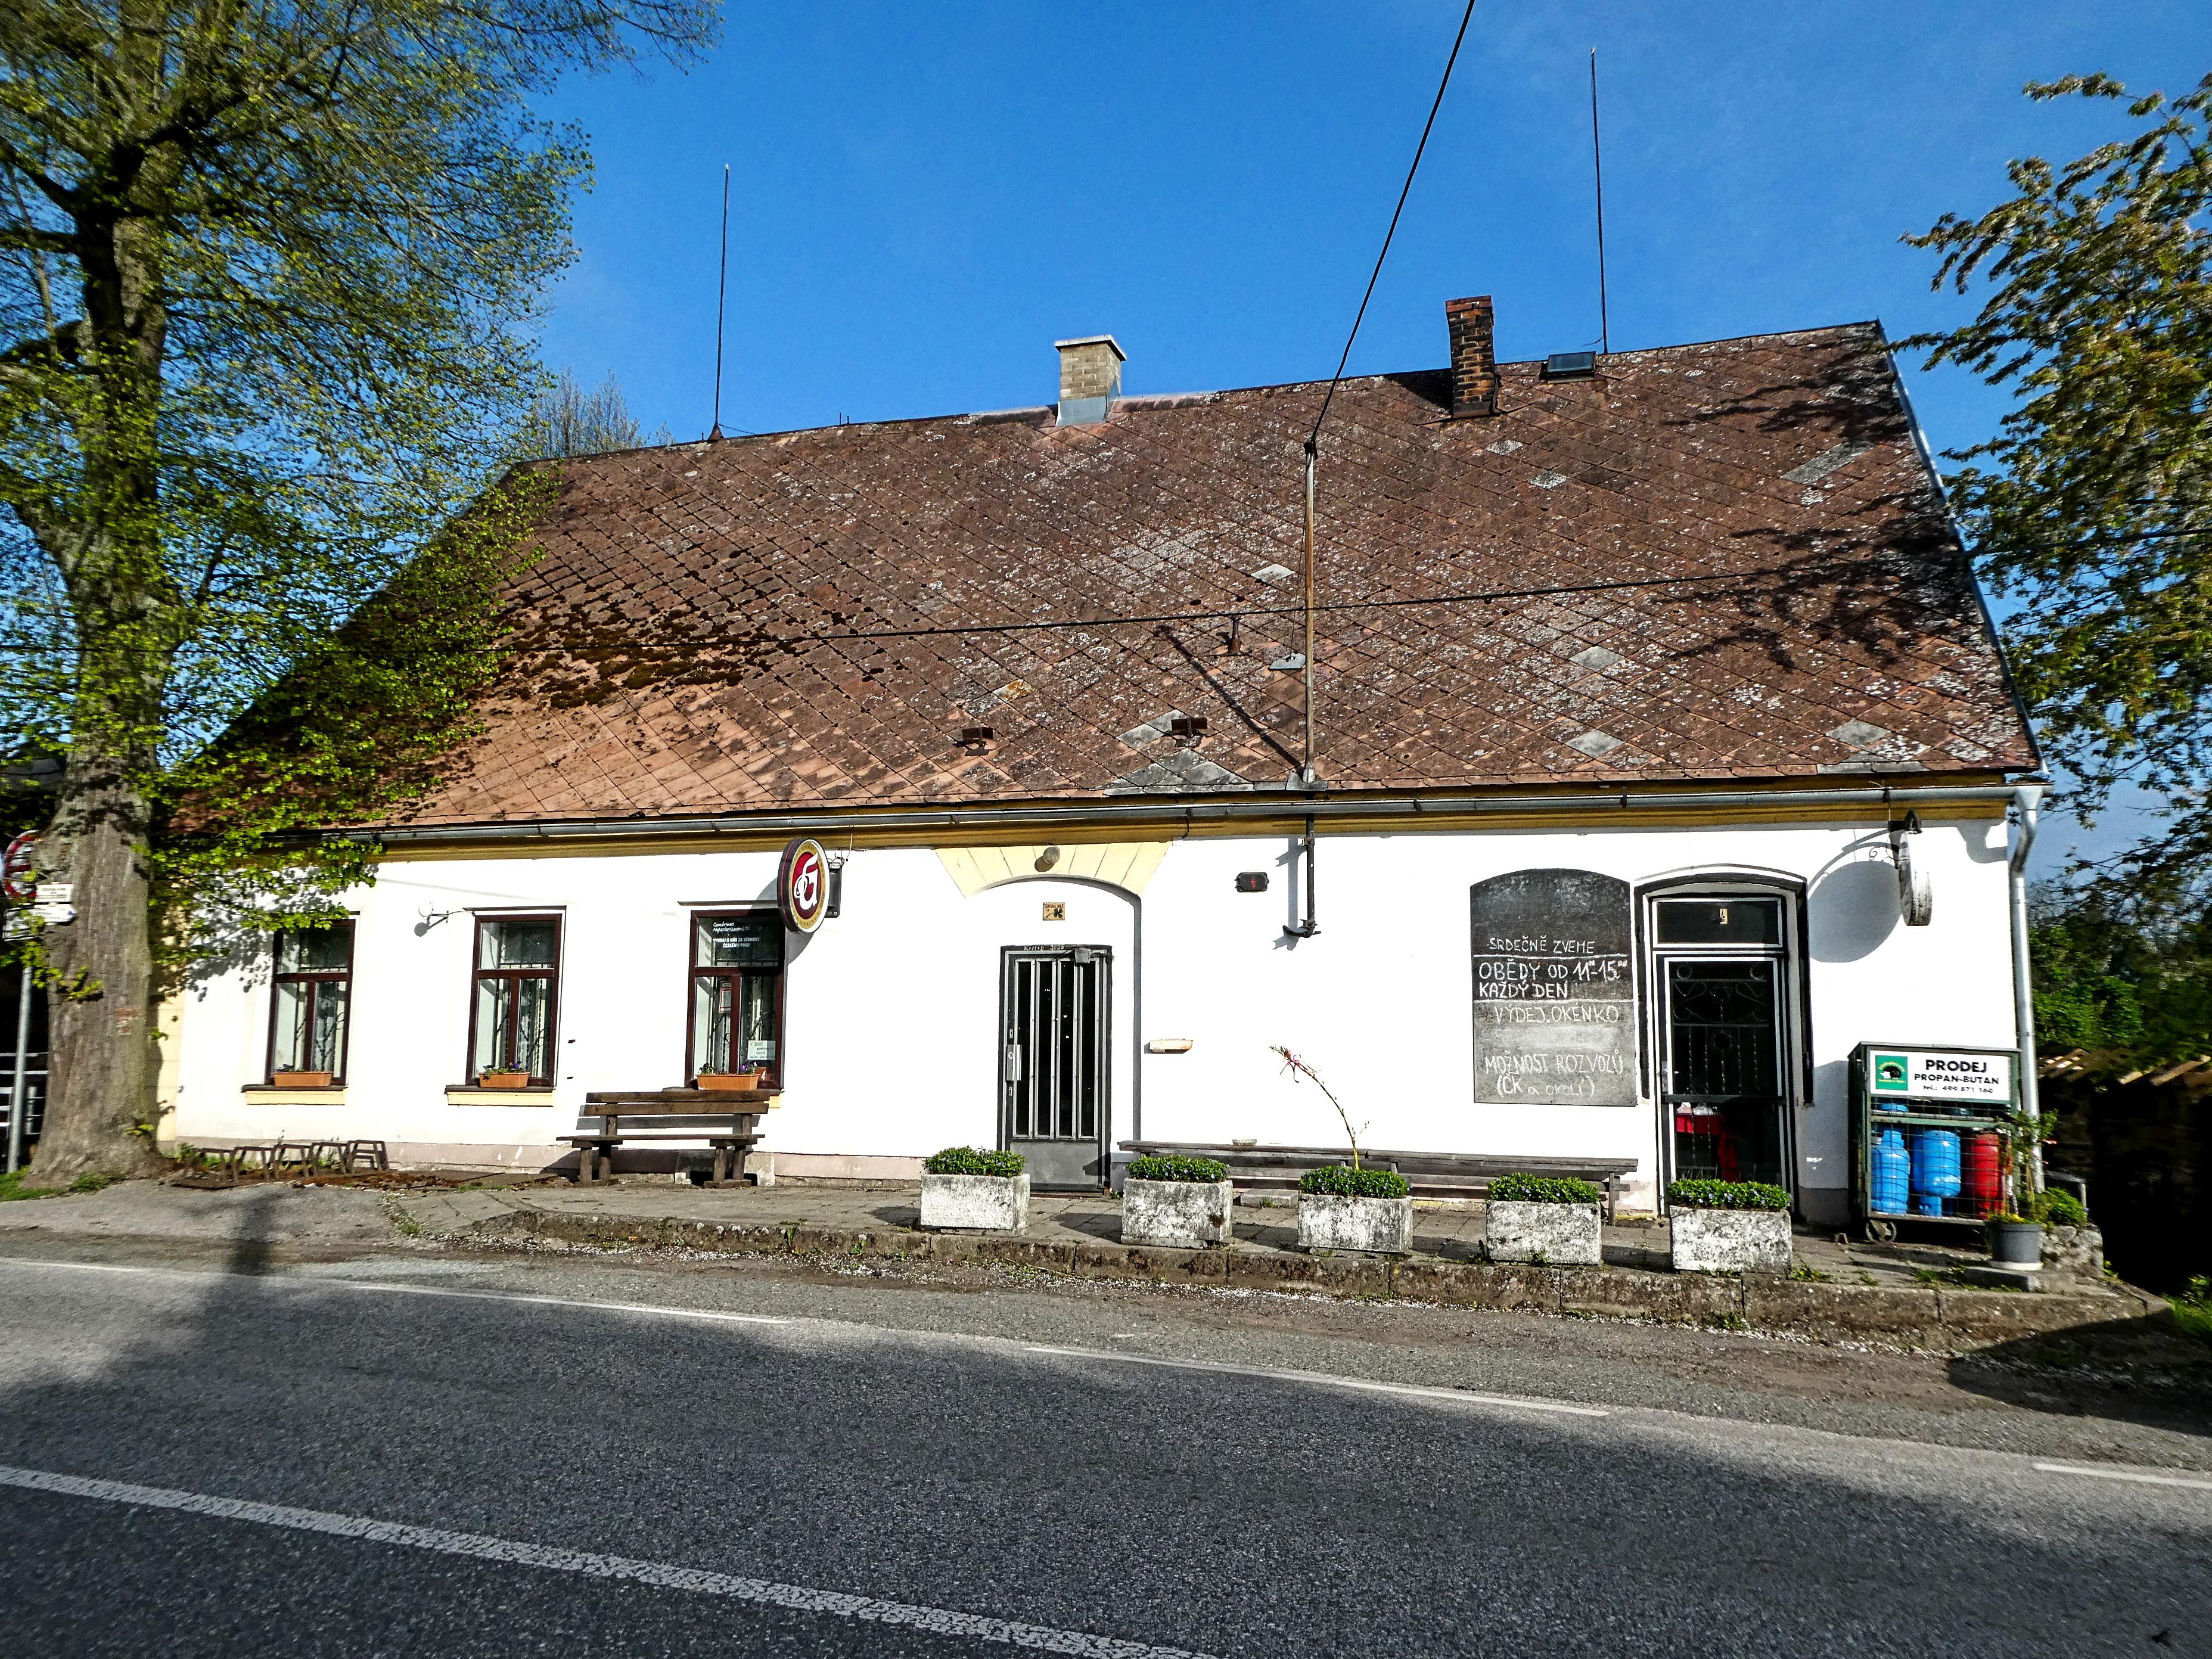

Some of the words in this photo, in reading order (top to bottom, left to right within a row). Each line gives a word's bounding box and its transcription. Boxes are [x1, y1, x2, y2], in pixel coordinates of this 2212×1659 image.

[1488, 935, 1547, 952] SRDEČNĚ
[1553, 940, 1595, 954] ZVEME
[1478, 958, 1540, 981] OBĚDY
[1548, 964, 1568, 979] OD
[1479, 979, 1530, 999] KAŽDÝ
[1531, 981, 1568, 999] DEN
[1484, 1049, 1548, 1075] MOŽNOST
[1555, 1049, 1624, 1074] ROZVOZŮ
[1925, 1059, 1987, 1073] PRODEJ
[1913, 1073, 2000, 1085] PROPAN-BUTAN
